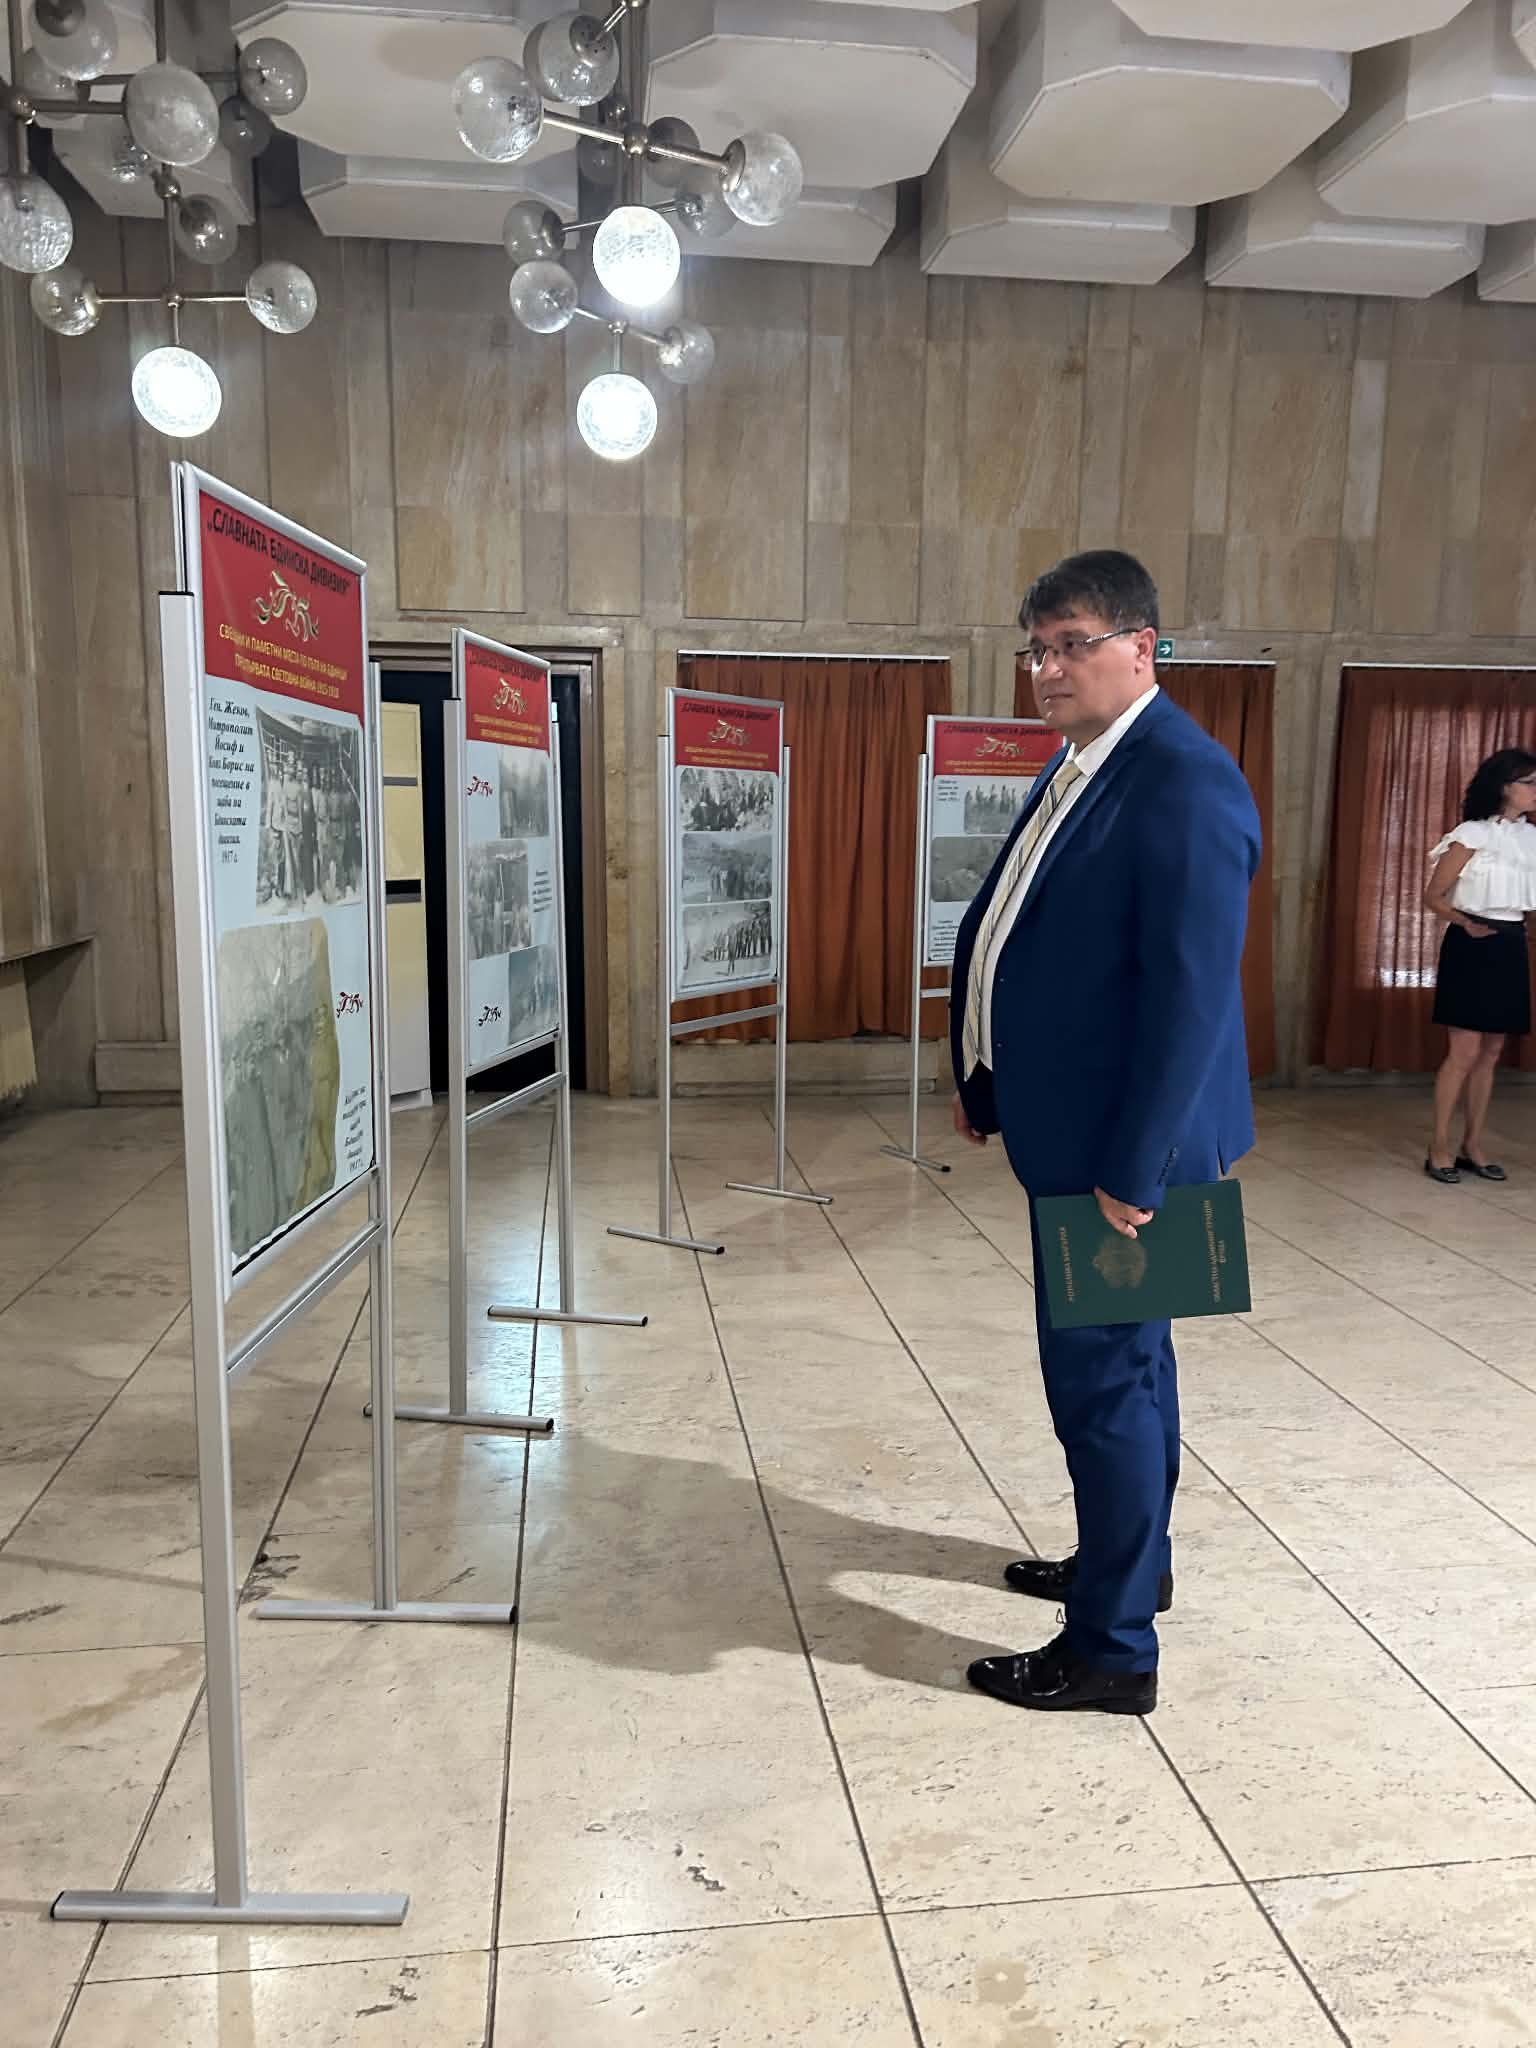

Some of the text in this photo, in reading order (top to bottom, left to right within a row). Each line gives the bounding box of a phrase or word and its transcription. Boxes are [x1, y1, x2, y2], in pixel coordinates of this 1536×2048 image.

[209, 697, 222, 712] Ген.
[208, 716, 253, 735] Митрополит
[215, 734, 244, 755] Йосиф и
[222, 757, 244, 773] Борис
[245, 762, 255, 772] на
